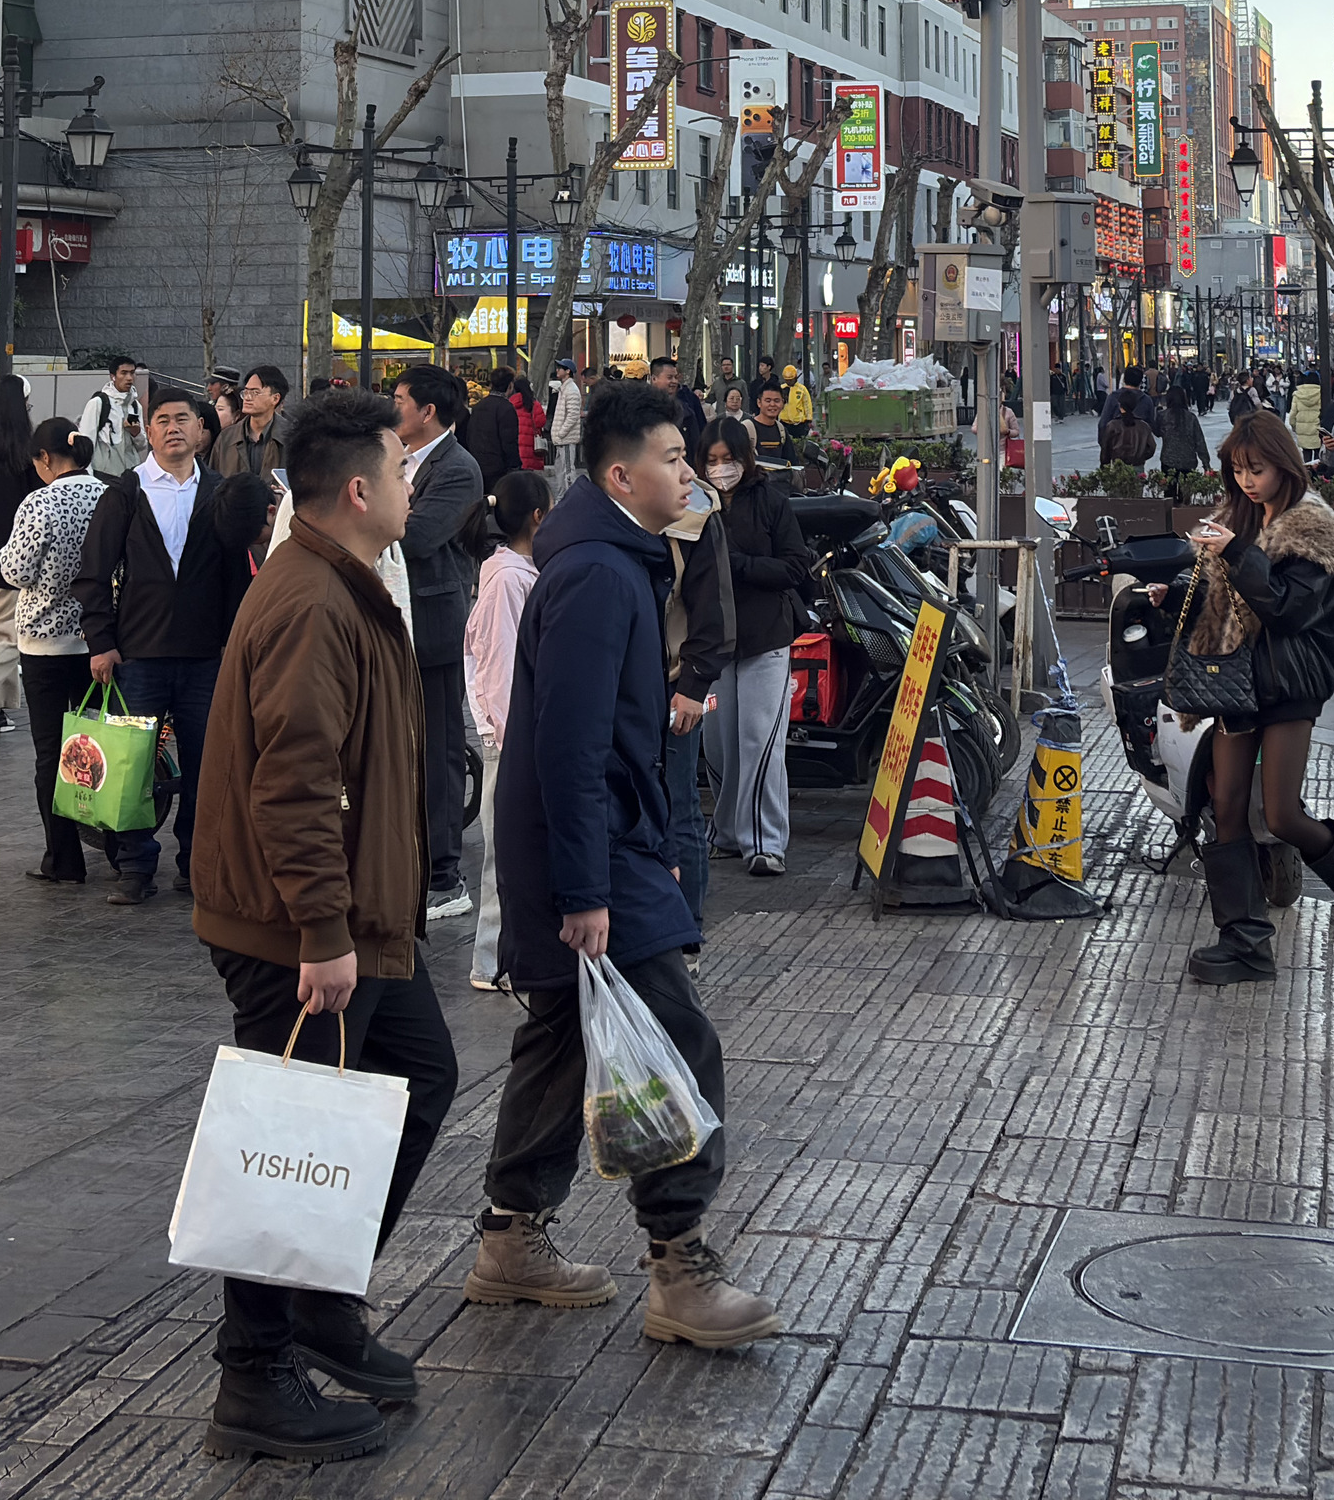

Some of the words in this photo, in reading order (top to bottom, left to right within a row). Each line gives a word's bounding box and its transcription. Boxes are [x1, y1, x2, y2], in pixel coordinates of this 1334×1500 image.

[850, 100, 873, 109] 家补贴
[1138, 124, 1148, 164] NINGQI
[447, 236, 591, 270] 牧心电
[609, 240, 655, 276] 牧心电竞
[468, 307, 527, 335] 泰国金枕莲
[837, 321, 856, 333] 九机
[939, 312, 963, 321] 公安监控
[912, 621, 938, 668] 出租车
[1048, 798, 1071, 867] 禁止停车
